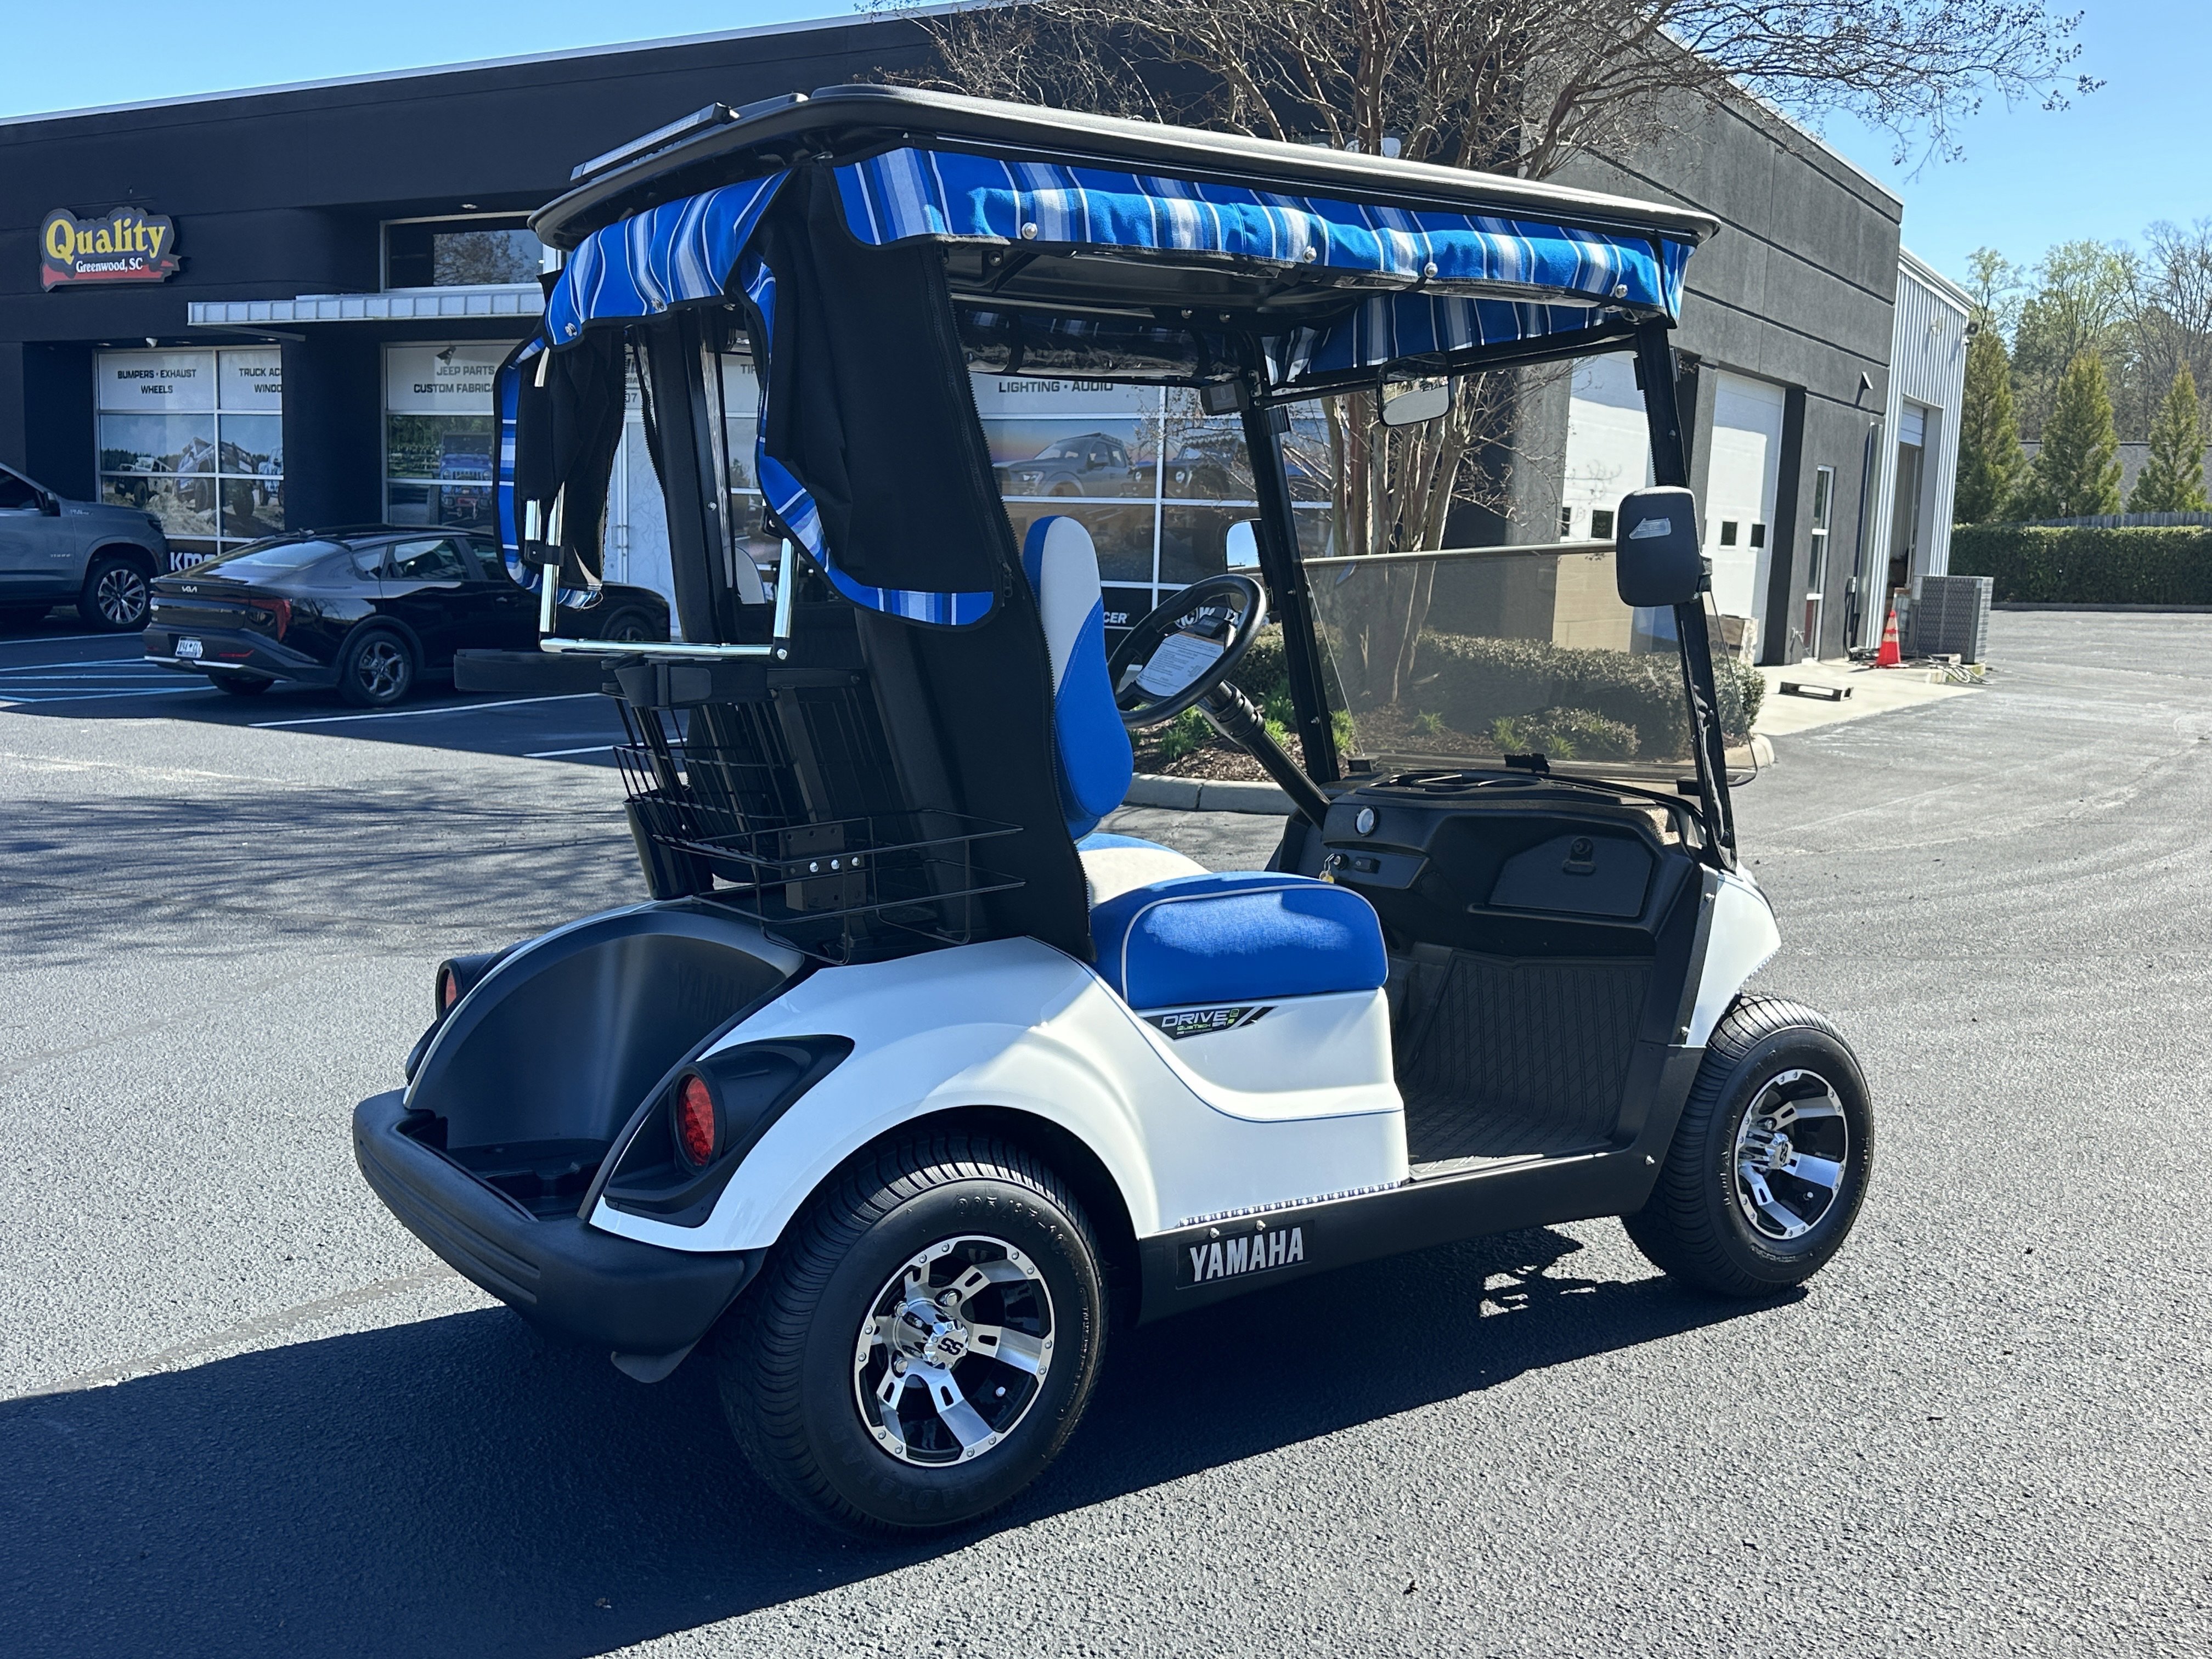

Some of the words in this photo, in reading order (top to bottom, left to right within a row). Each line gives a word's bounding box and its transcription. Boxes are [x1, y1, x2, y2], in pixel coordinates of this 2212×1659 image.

[46, 218, 166, 265] Quality
[76, 260, 128, 273] Greenwood,
[129, 257, 143, 270] SC
[117, 370, 154, 379] BUMPERS
[160, 369, 196, 378] EXHAUST
[239, 368, 267, 377] TRUCK
[269, 368, 282, 377] AC
[437, 366, 460, 376] JEEP
[463, 365, 495, 375] PARTS
[140, 385, 173, 394] WHEELS
[414, 383, 454, 393] CUSTOM
[998, 381, 1060, 393] LIGHTING
[1189, 1227, 1304, 1282] YAMAHA
